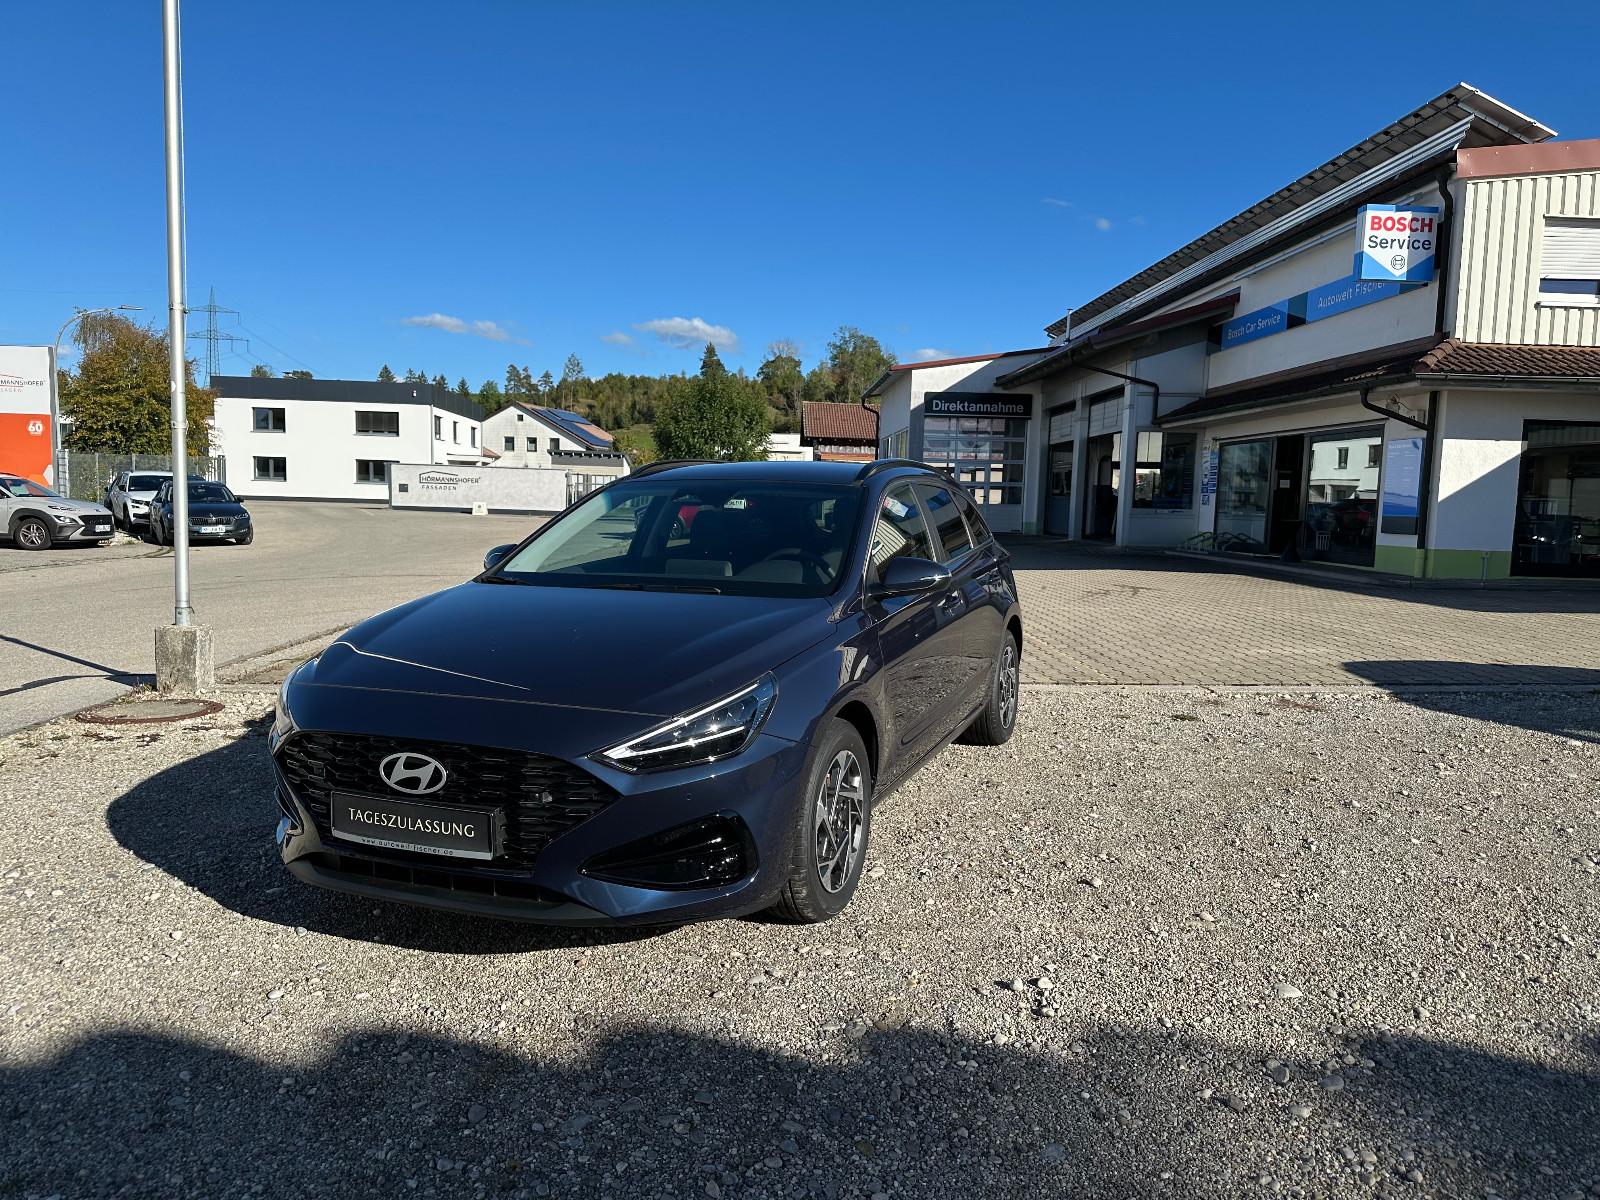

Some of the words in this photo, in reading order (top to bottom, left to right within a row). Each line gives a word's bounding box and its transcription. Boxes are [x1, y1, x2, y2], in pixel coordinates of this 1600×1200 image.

[1370, 215, 1433, 233] BOSCH
[1368, 234, 1432, 250] Service
[1245, 322, 1257, 334] Car
[1257, 313, 1281, 330] Service
[932, 399, 1025, 413] Direktannahme
[28, 422, 43, 433] 60
[348, 807, 475, 838] TAGESZULASSUNG
